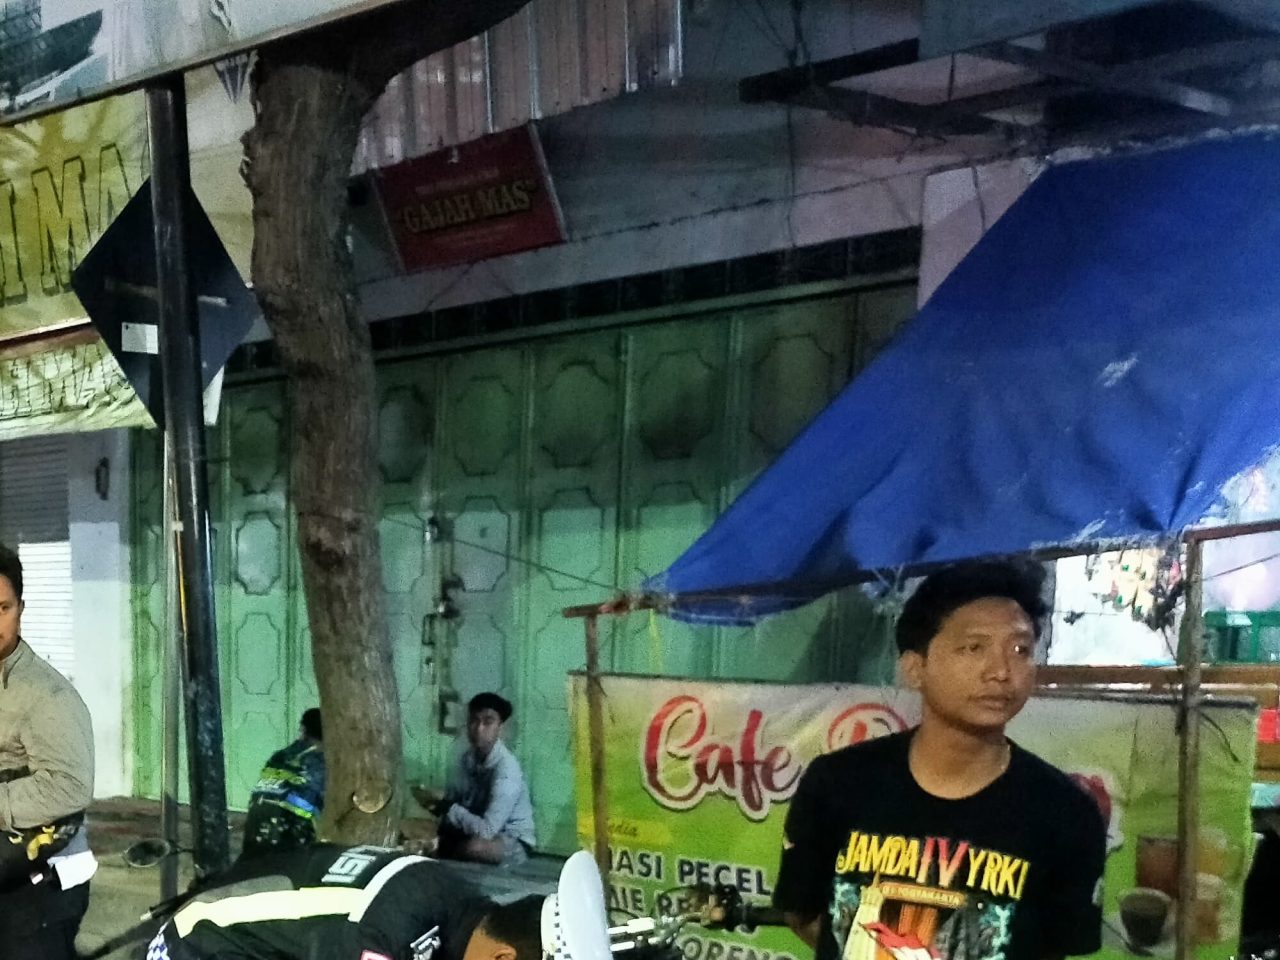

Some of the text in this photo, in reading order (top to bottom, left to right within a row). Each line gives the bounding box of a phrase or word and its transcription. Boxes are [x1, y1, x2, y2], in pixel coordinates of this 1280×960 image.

[31, 139, 149, 297] MA
[403, 194, 476, 232] GAJAH
[644, 695, 802, 811] Cafe
[678, 858, 771, 895] PECEL
[916, 836, 970, 888] IV
